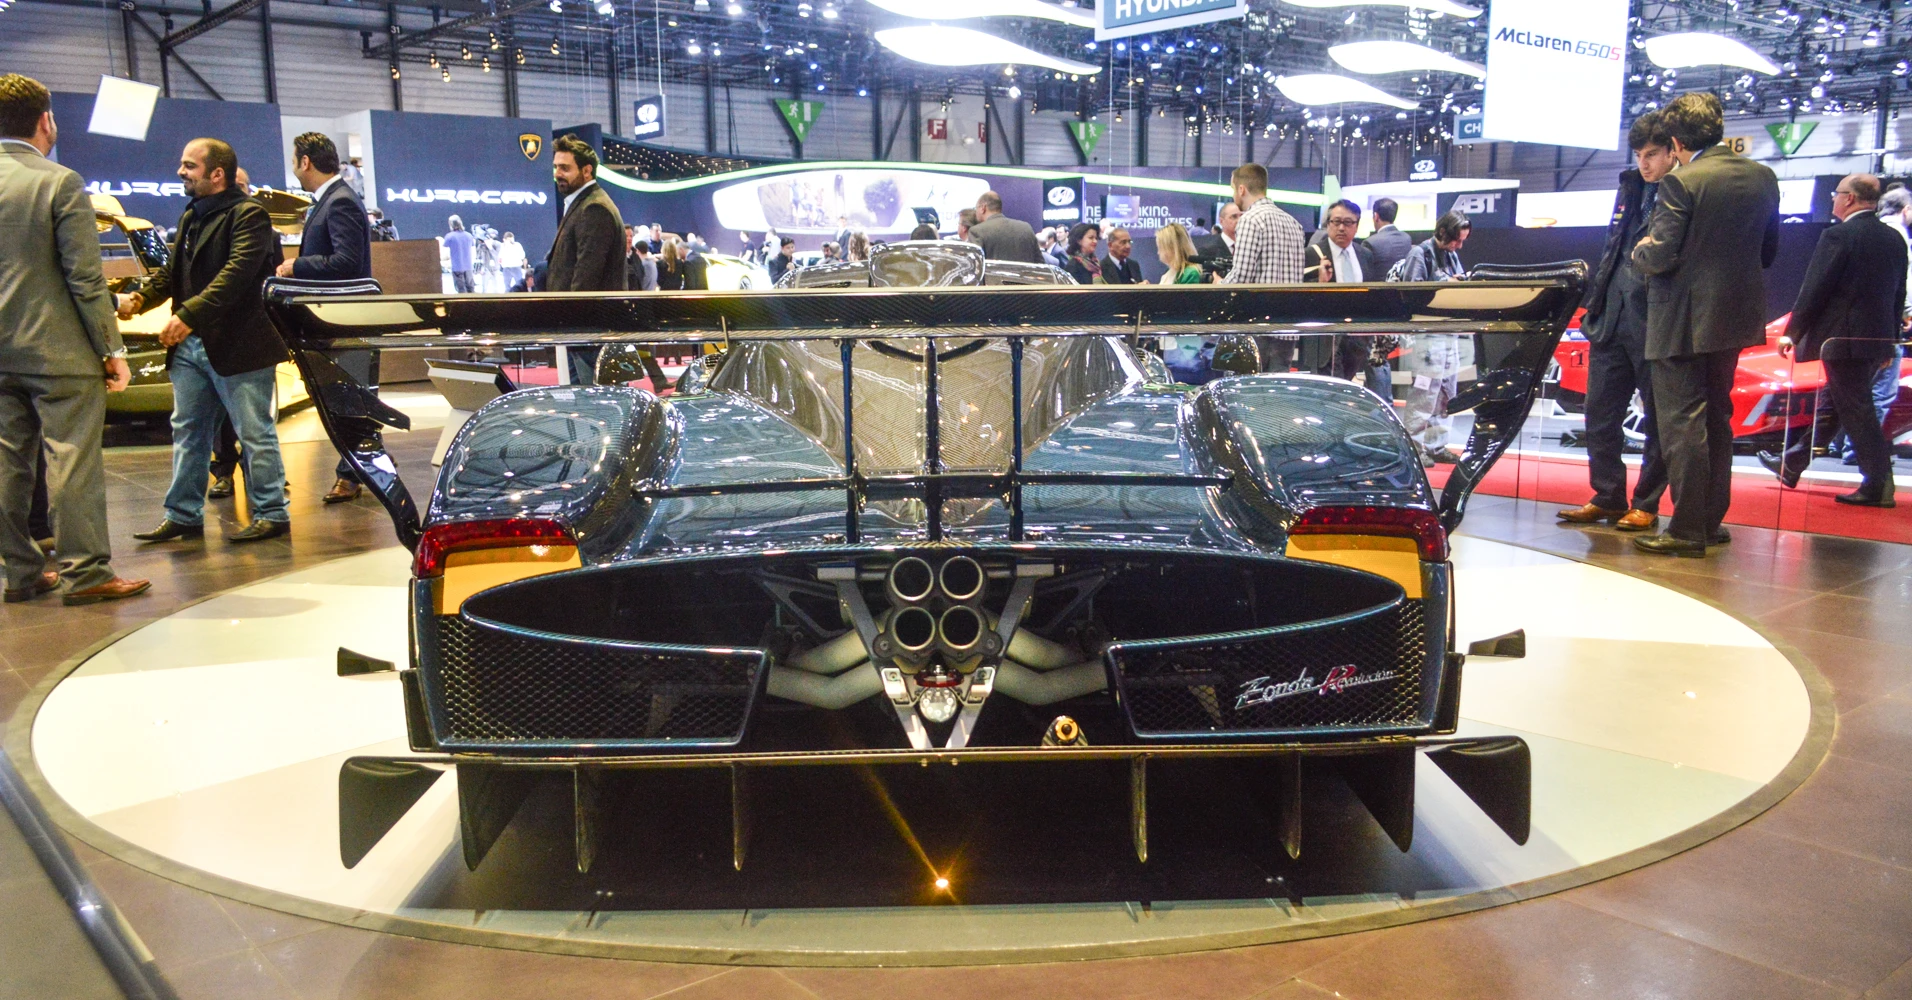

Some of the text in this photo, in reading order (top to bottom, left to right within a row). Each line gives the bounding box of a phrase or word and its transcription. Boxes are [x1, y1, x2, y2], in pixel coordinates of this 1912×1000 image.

[121, 2, 135, 11] 29
[390, 25, 400, 34] 31
[1494, 27, 1621, 60] McLaren 650S
[933, 120, 944, 135] F
[386, 187, 548, 205] HURACAN
[1234, 667, 1315, 710] Zonda
